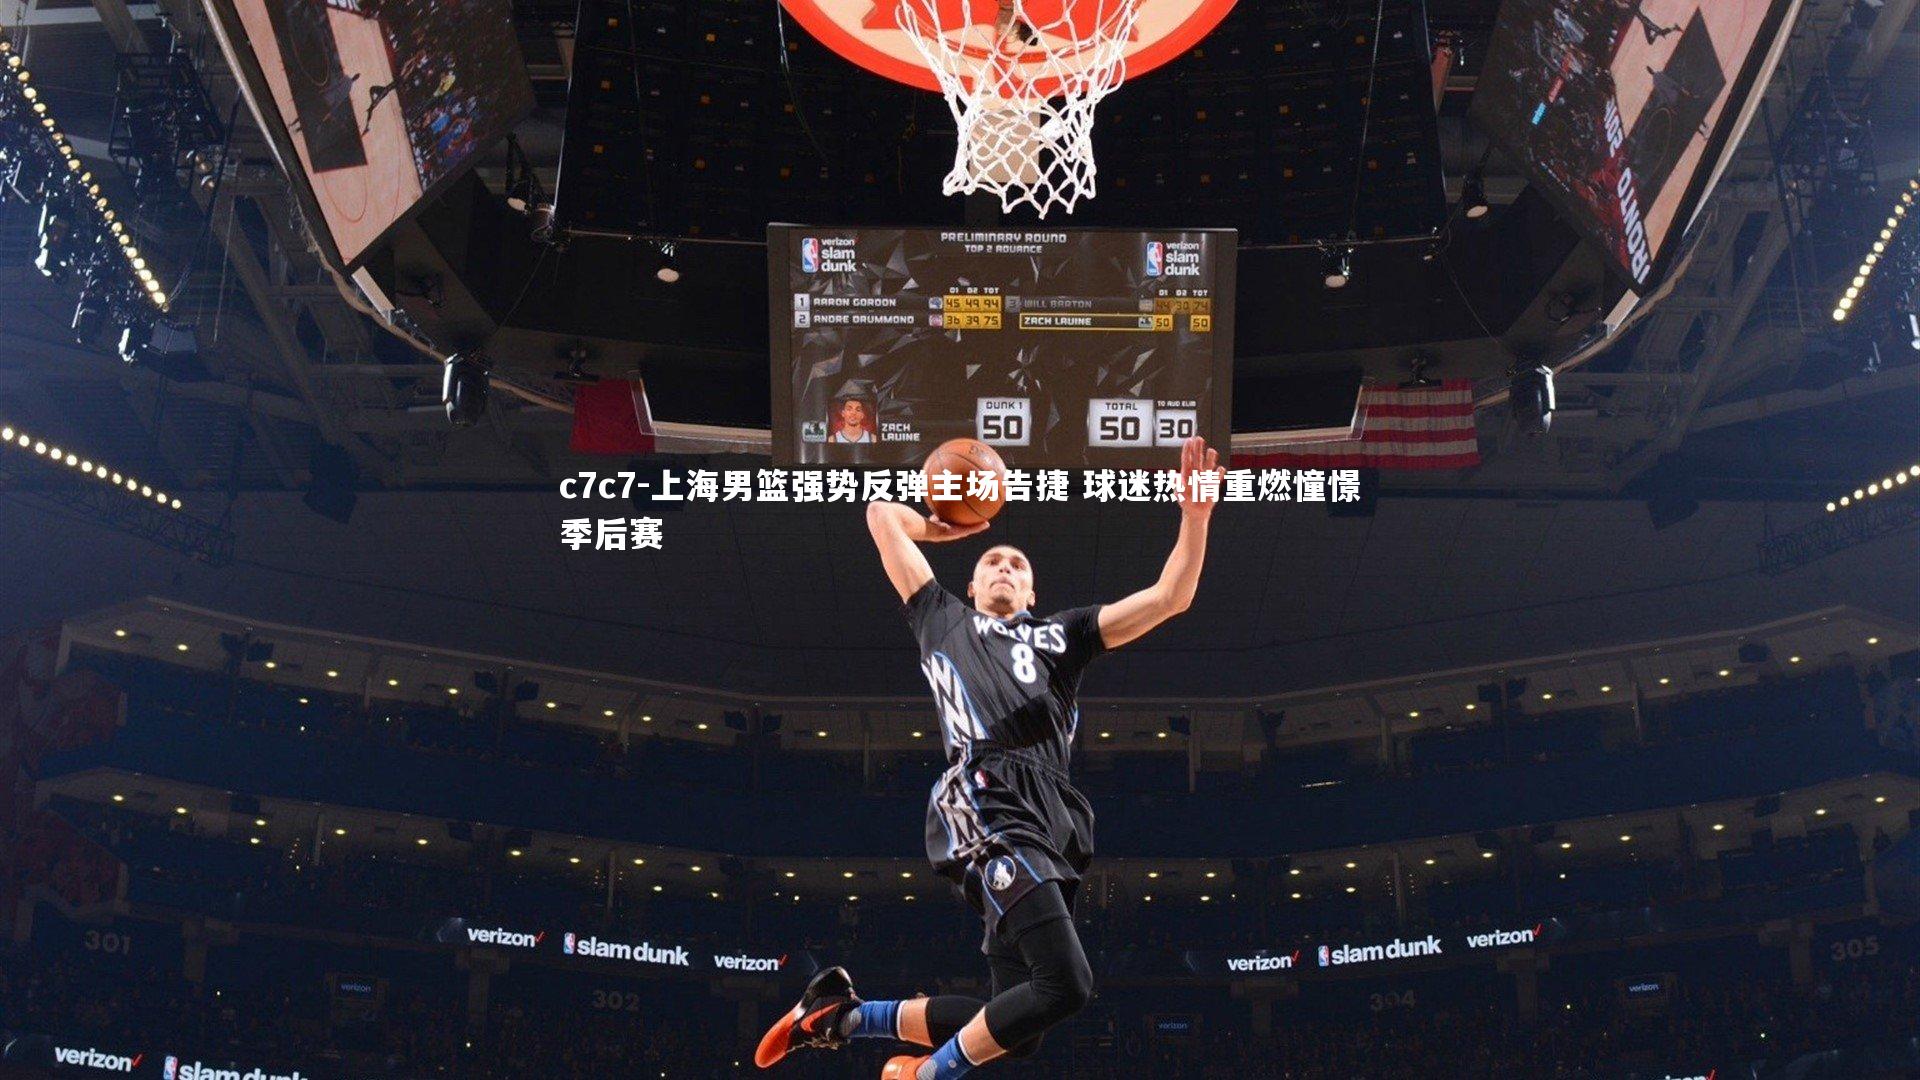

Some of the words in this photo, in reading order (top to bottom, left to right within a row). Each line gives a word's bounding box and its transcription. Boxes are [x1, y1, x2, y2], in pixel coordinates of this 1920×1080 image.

[1617, 167, 1650, 284] RONTO
[821, 237, 854, 246] verizon
[941, 233, 1021, 242] PRELIMINARY
[1025, 234, 1067, 243] ROUND
[1166, 241, 1199, 250] verizon
[821, 246, 855, 259] slam
[1166, 250, 1199, 263] slam
[821, 259, 857, 272] dunk
[1165, 263, 1200, 275] dunk
[800, 297, 805, 307] 1
[814, 298, 850, 307] AARON
[853, 298, 897, 307] GORDON
[946, 299, 960, 308] 45
[965, 299, 980, 308] 49
[983, 299, 999, 308] 94
[1024, 299, 1047, 308] WILL
[1050, 299, 1092, 309] BARTON
[1193, 301, 1208, 310] 74
[799, 315, 806, 324] 2
[814, 315, 850, 324] ANDRE
[852, 315, 915, 324] DRUMMOND
[965, 316, 980, 325] 39
[983, 316, 999, 325] 75
[1024, 317, 1052, 325] ZACH
[1156, 318, 1170, 327] 50
[1193, 318, 1208, 327] 50
[985, 401, 1015, 409] DUNK
[1105, 402, 1138, 410] TOTAL
[881, 423, 911, 432] ZACH
[983, 415, 1023, 439] 50
[1100, 416, 1140, 441] 50
[1159, 418, 1193, 438] 30
[973, 615, 1067, 654] WOLVES
[1011, 643, 1037, 683] 8
[467, 927, 535, 948] verizon
[1466, 929, 1534, 948] verizon
[576, 936, 632, 960] slam
[633, 941, 690, 966] dunk
[1331, 944, 1384, 965] slam
[1385, 934, 1443, 959] dunk
[714, 954, 779, 971] verizon
[1227, 955, 1292, 972] verizon
[54, 1046, 132, 1072] verizon
